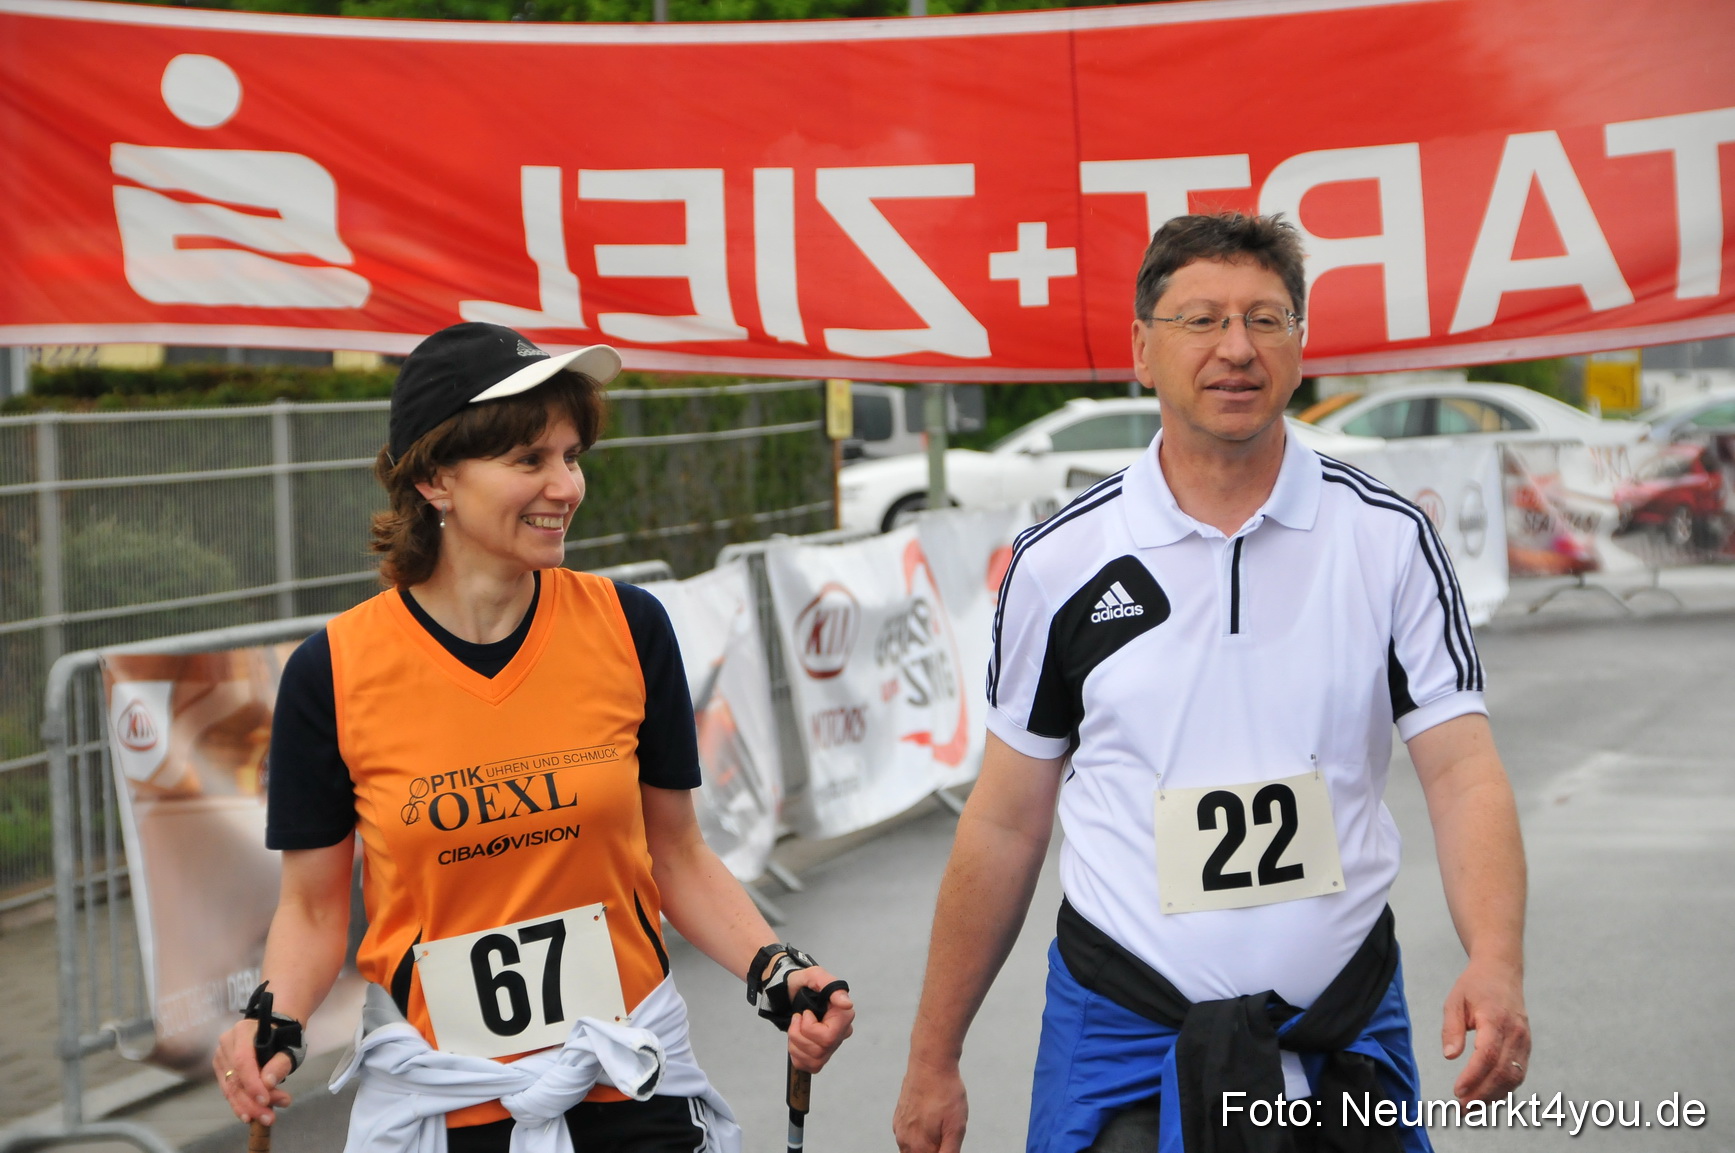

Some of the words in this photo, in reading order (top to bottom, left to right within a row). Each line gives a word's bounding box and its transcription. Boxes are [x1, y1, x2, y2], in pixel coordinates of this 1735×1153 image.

[1091, 603, 1144, 623] adidas
[486, 761, 530, 778] UHREN
[533, 756, 560, 770] UND
[563, 747, 619, 765] SCHMUCK
[428, 771, 578, 831] OEXL
[438, 843, 486, 866] CIBA
[508, 825, 581, 850] VISION
[1197, 783, 1304, 892] 22
[470, 918, 567, 1037] 67
